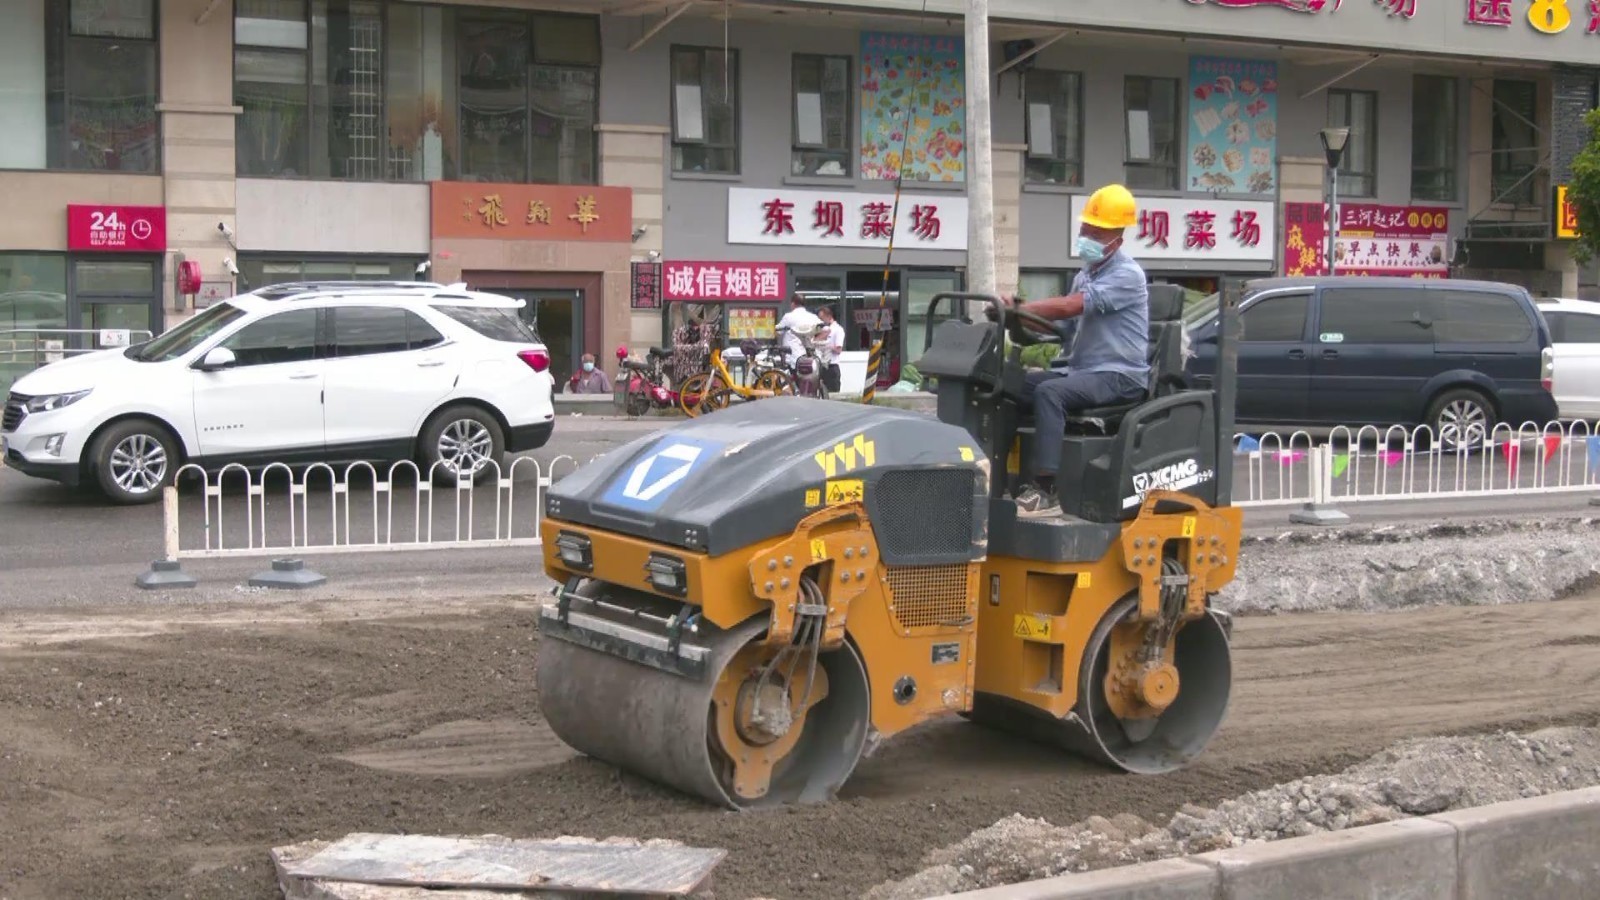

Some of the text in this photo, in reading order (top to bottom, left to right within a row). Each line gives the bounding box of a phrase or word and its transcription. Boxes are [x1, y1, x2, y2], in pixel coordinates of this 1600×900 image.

[90, 211, 126, 231] 24h
[762, 198, 941, 240] 东坝菜场
[1138, 209, 1262, 249] 坝菜场
[1344, 209, 1405, 229] 三河赵记
[90, 231, 126, 240] 自助银行
[1348, 240, 1422, 258] 早点快餐
[667, 266, 780, 298] 诚信烟酒
[1150, 458, 1198, 487] XCMG
